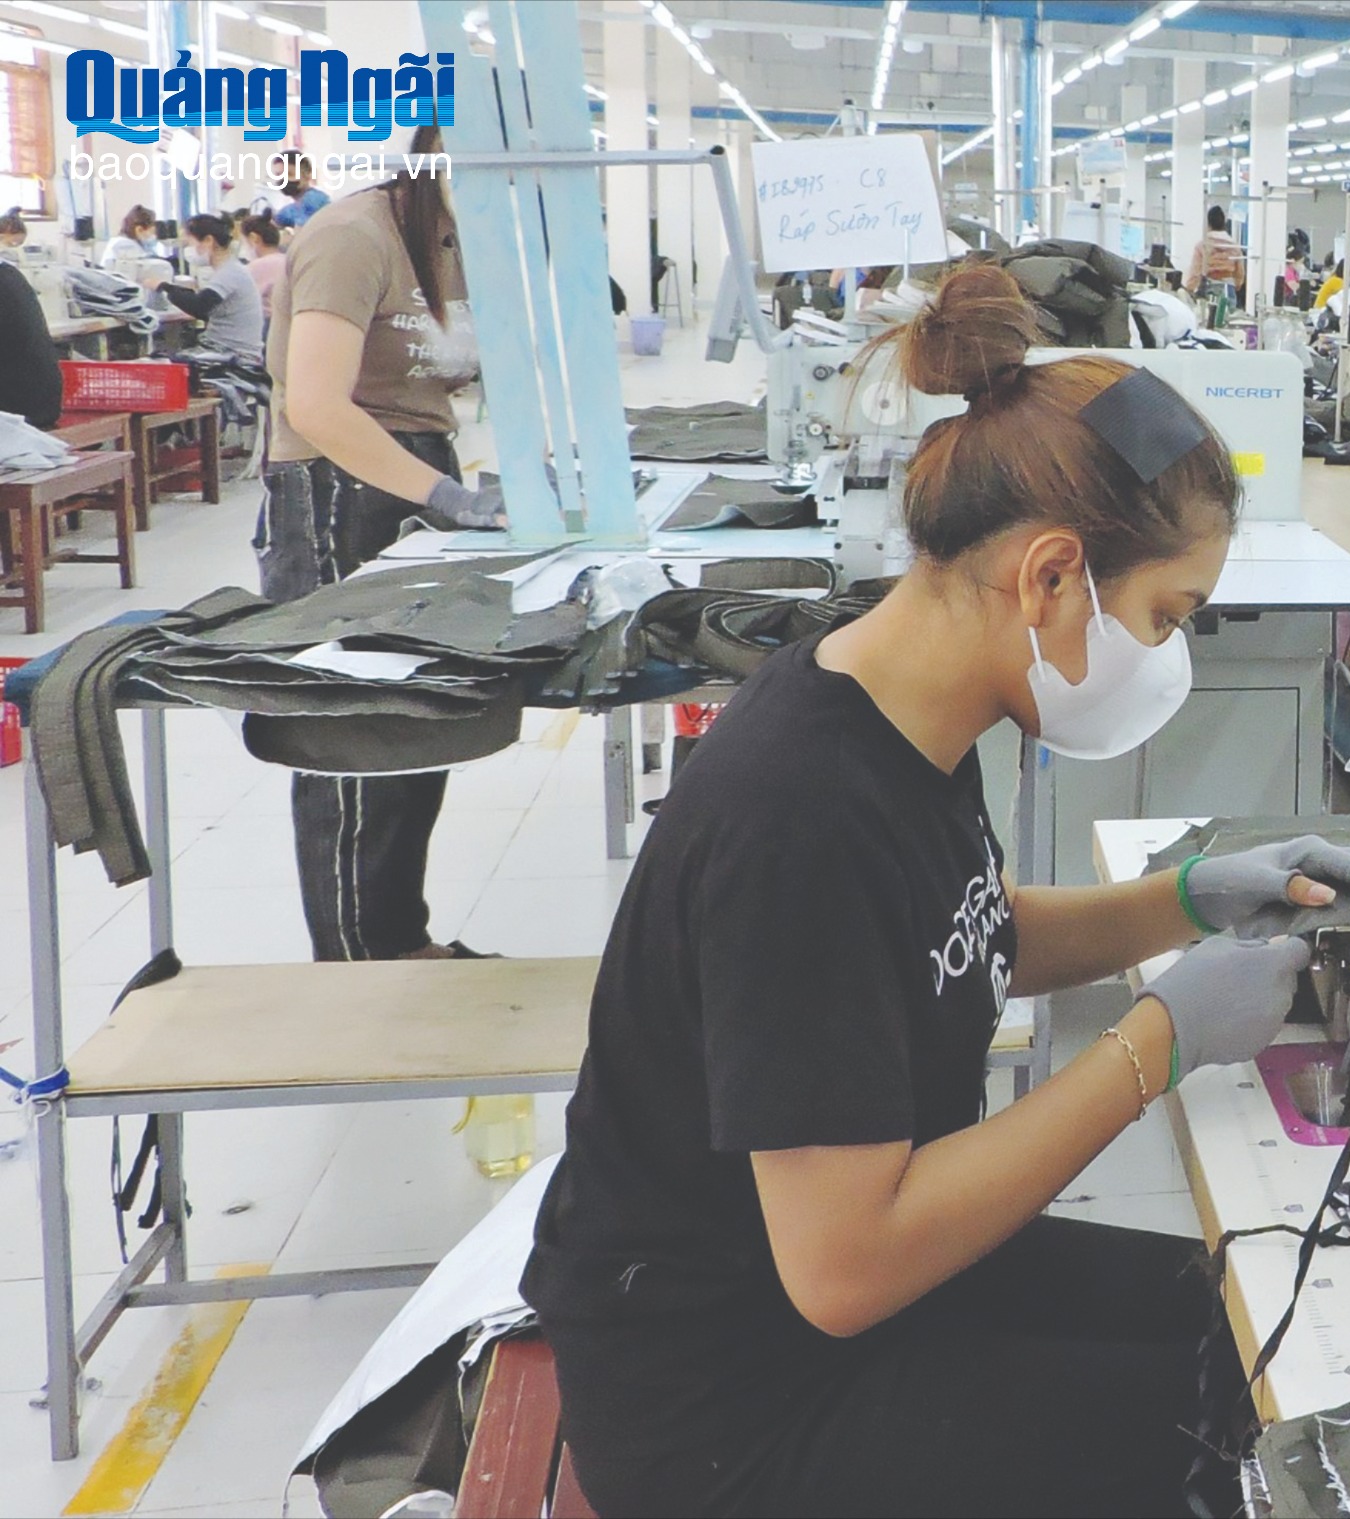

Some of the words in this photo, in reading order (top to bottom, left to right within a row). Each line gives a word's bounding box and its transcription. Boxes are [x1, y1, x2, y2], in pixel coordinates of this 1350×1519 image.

[860, 168, 887, 188] C8
[884, 201, 922, 234] Tay
[1205, 387, 1284, 399] NICERBT
